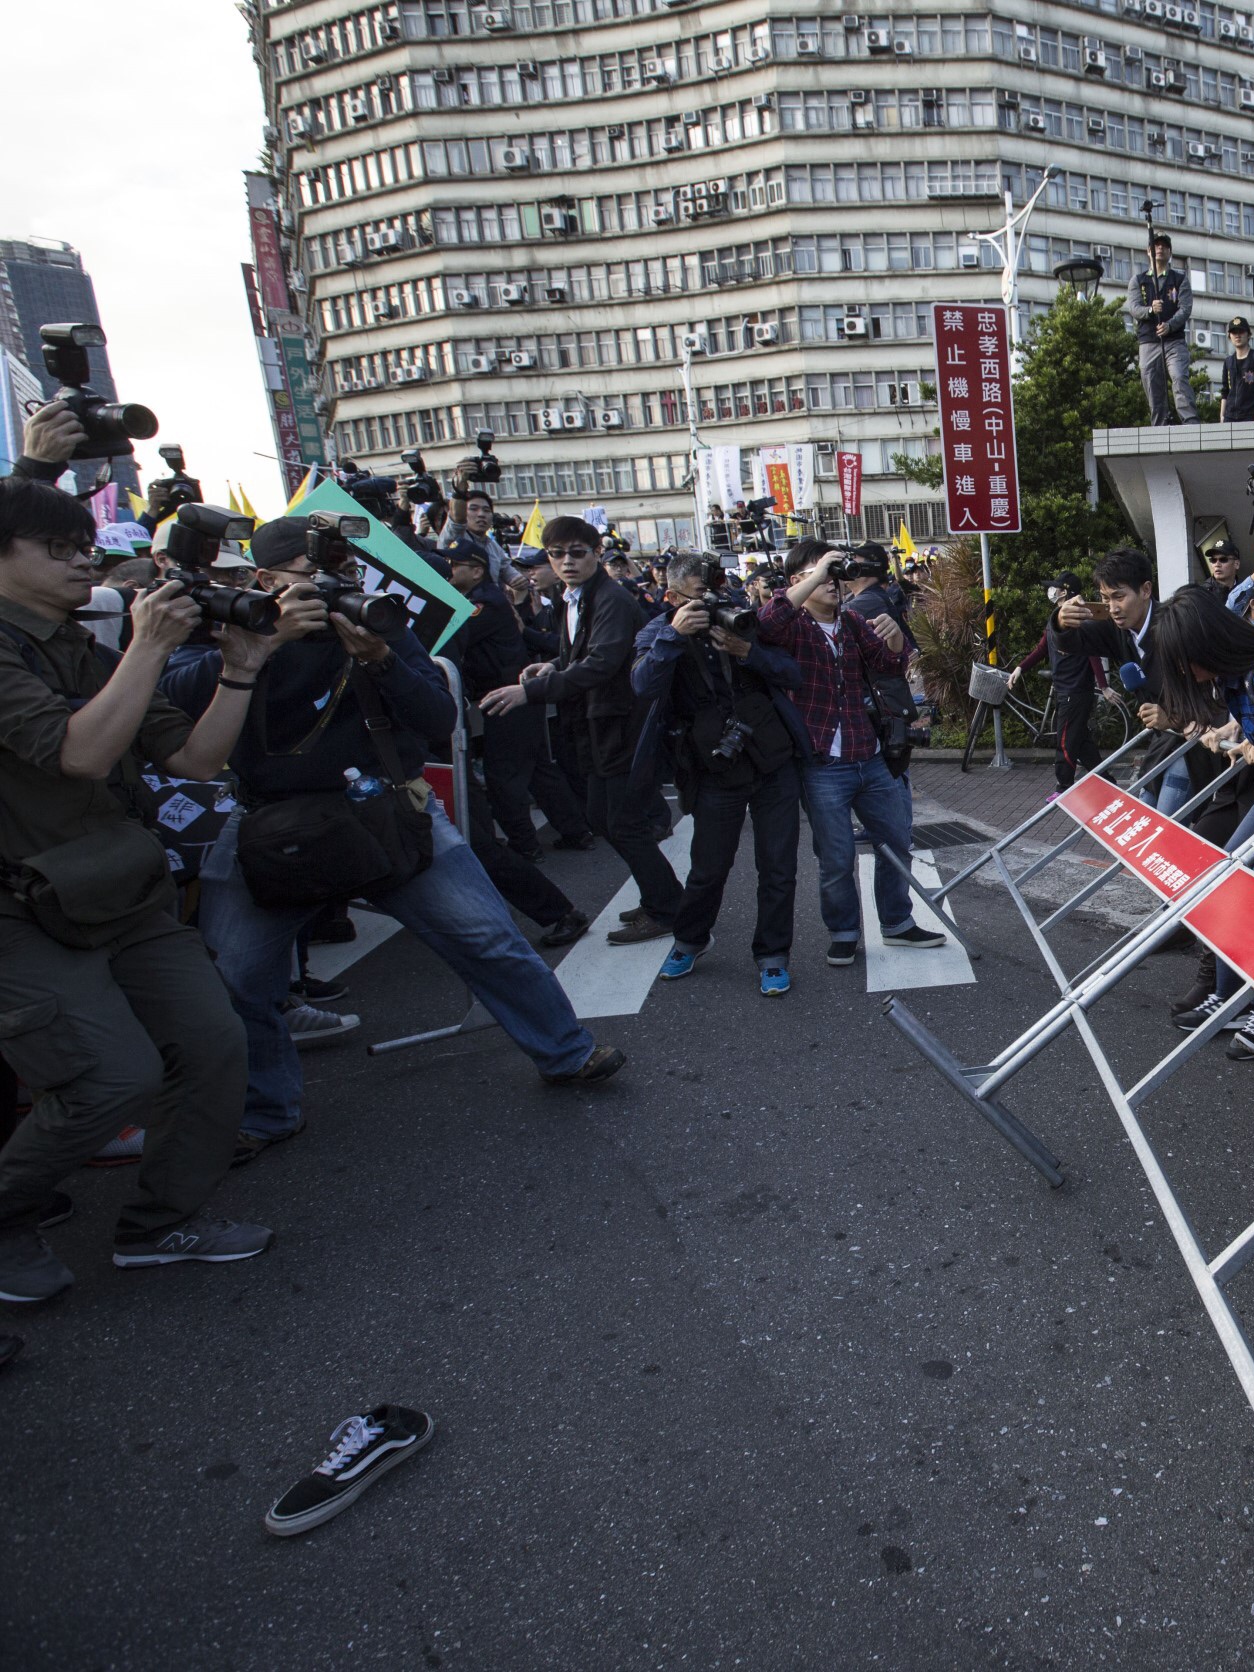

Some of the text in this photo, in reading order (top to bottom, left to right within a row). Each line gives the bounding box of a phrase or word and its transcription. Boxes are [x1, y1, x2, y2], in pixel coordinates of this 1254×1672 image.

[942, 310, 978, 528] 禁止機慢車進入
[1092, 798, 1164, 857] 禁止進入
[1141, 851, 1191, 892] 新竹市警察局
